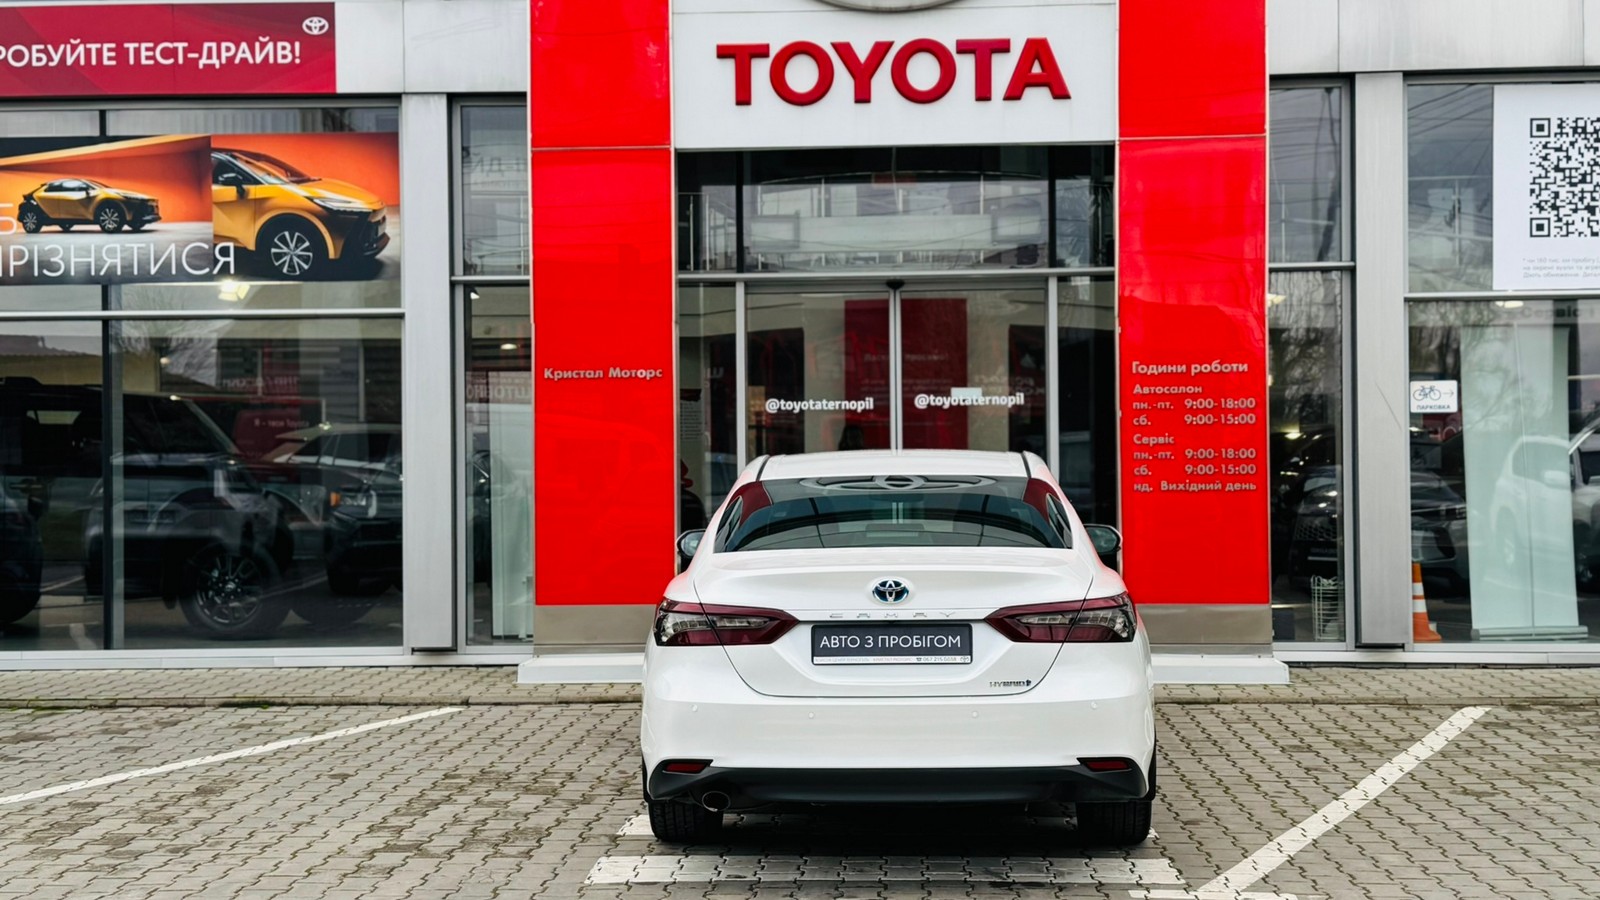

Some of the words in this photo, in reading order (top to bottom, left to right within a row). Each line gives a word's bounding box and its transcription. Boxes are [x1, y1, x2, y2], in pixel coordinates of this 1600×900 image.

[124, 36, 301, 69] ТЕСТ-ДРАЙВ!
[716, 37, 1072, 107] TOYOTA
[0, 241, 235, 277] РІЗНЯТИСЯ
[543, 367, 604, 381] Кристал
[608, 366, 663, 380] Моторс
[1131, 361, 1187, 375] Години
[1190, 359, 1249, 376] роботи
[1133, 384, 1202, 394] Автосалон
[765, 397, 874, 414] @toyotaternopil
[914, 392, 1025, 410] @toyotaternopil
[1133, 414, 1151, 426] сб.
[1133, 433, 1175, 447] Сервіс
[1133, 464, 1152, 476] сб.
[1133, 482, 1153, 493] нд.
[1160, 479, 1222, 492] Вихідний
[1225, 481, 1257, 492] день
[819, 635, 860, 648] АВТО
[878, 634, 962, 648] ПРОБІГОМ
